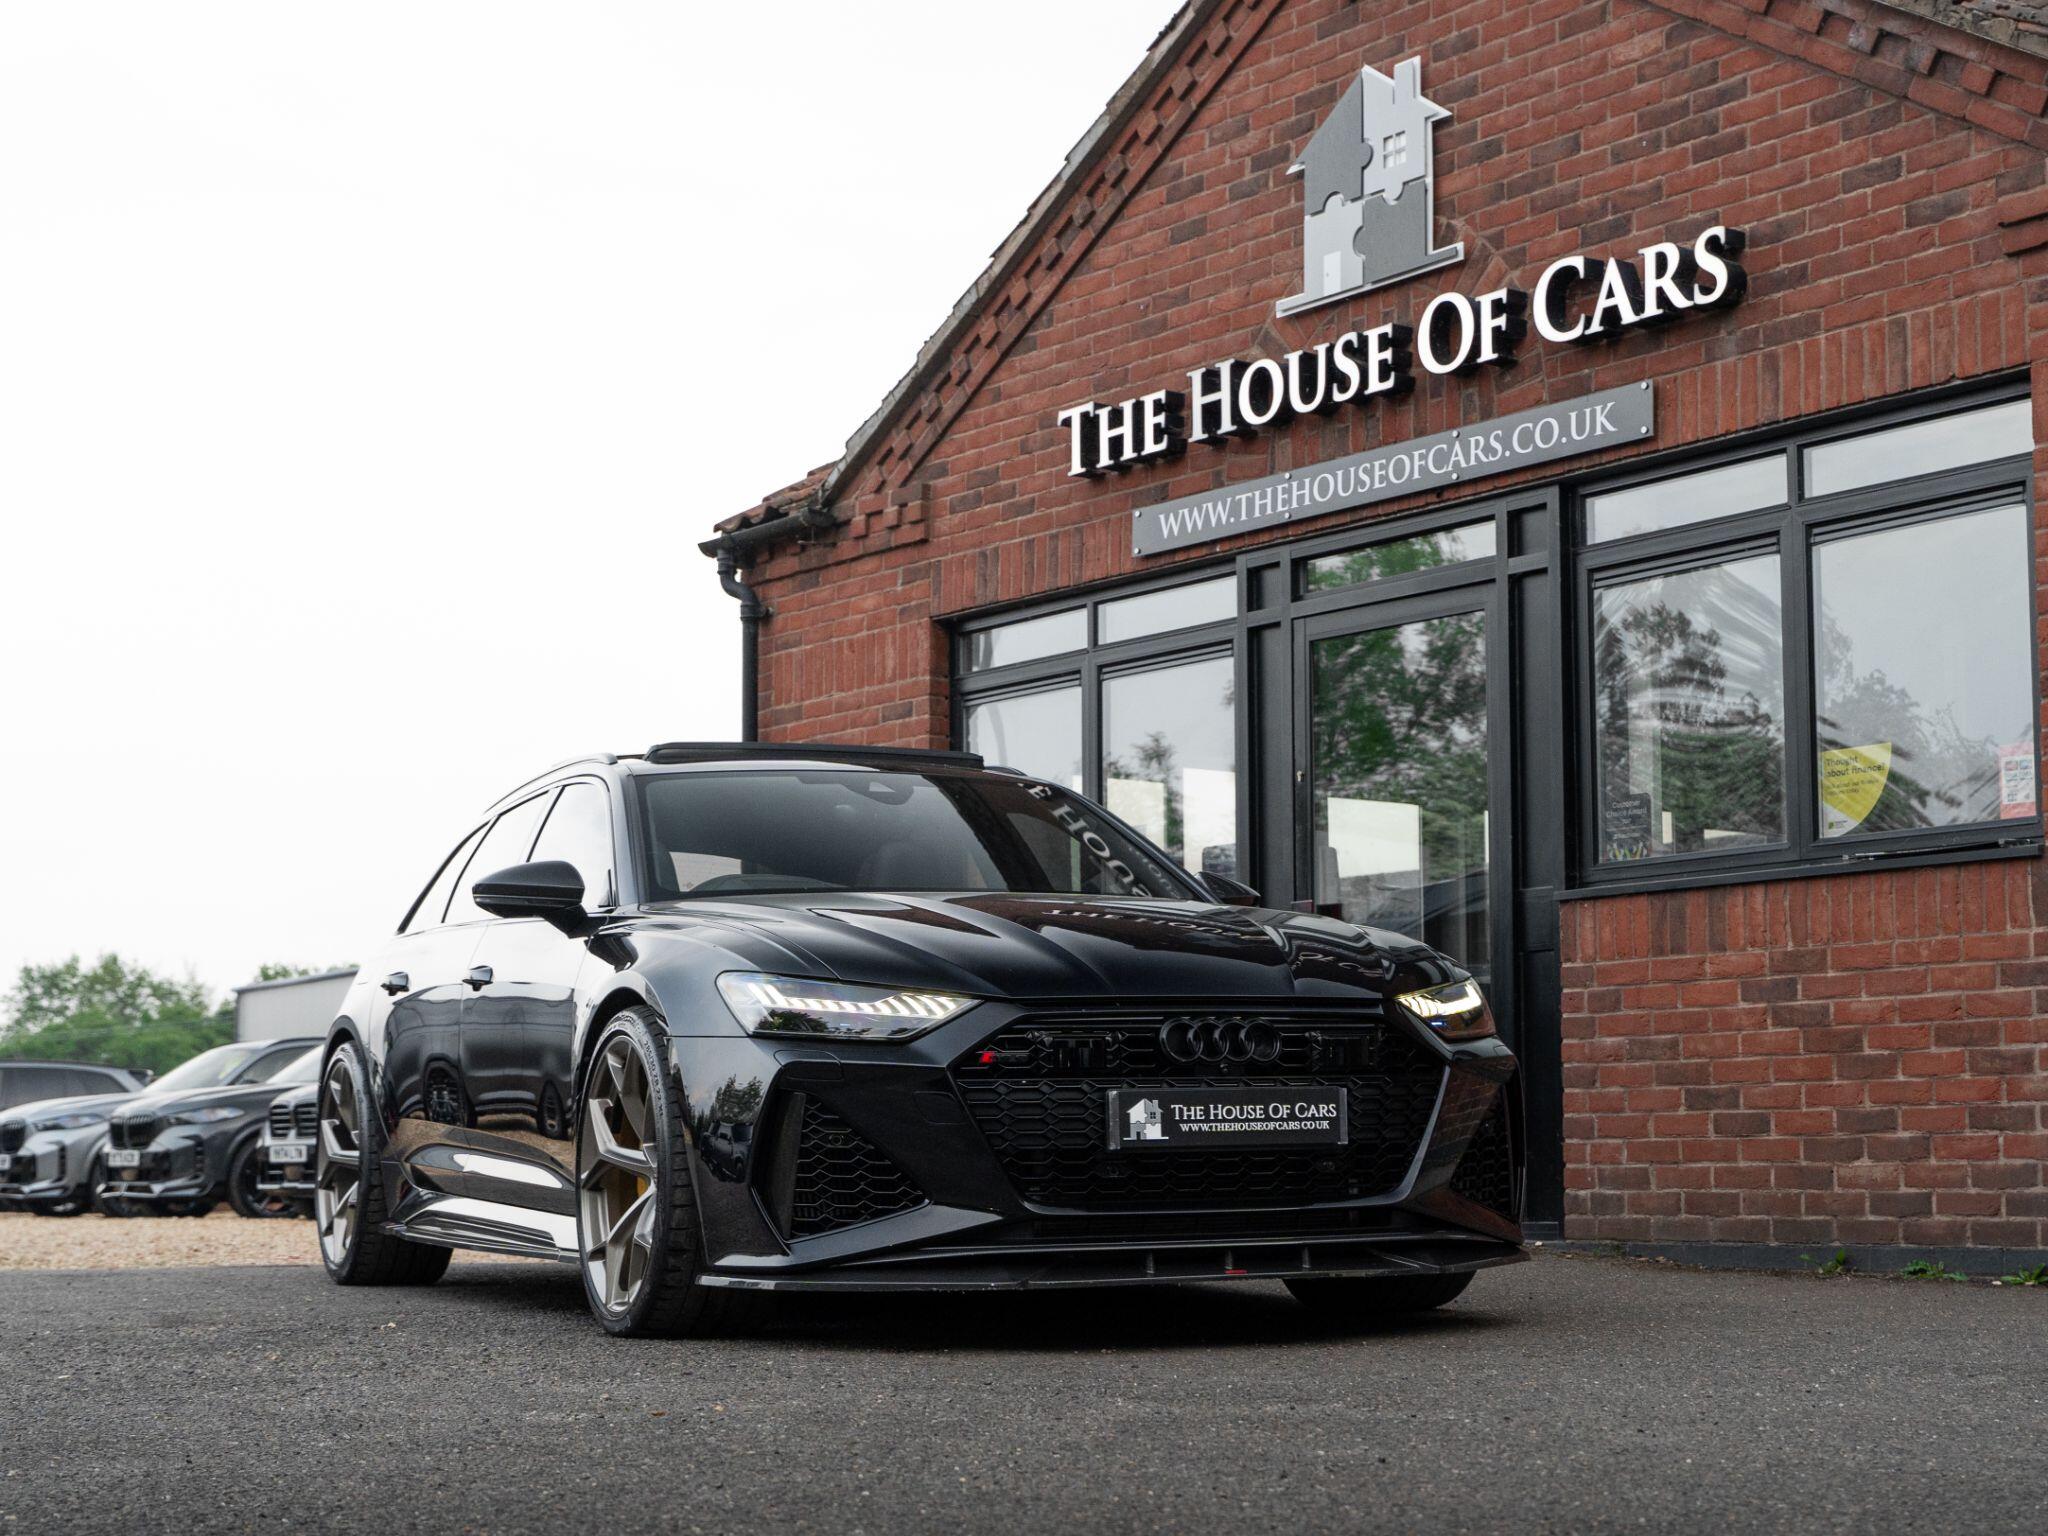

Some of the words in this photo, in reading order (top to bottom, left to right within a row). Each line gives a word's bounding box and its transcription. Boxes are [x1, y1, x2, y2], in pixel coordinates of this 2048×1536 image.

[1057, 389, 1168, 478] THE
[1187, 322, 1396, 444] HOUSE
[1417, 287, 1509, 376] OF
[1532, 225, 1730, 344] CARS
[1158, 400, 1618, 541] WWW.THEHOUSEOFCARS.CO.UK
[1171, 1104, 1205, 1120] THE
[1209, 1104, 1265, 1120] HOUSE
[1269, 1103, 1291, 1118] OF
[1295, 1102, 1337, 1118] CARS
[1179, 1120, 1330, 1132] WWW.THEHOUSEOFCARSCOUK
